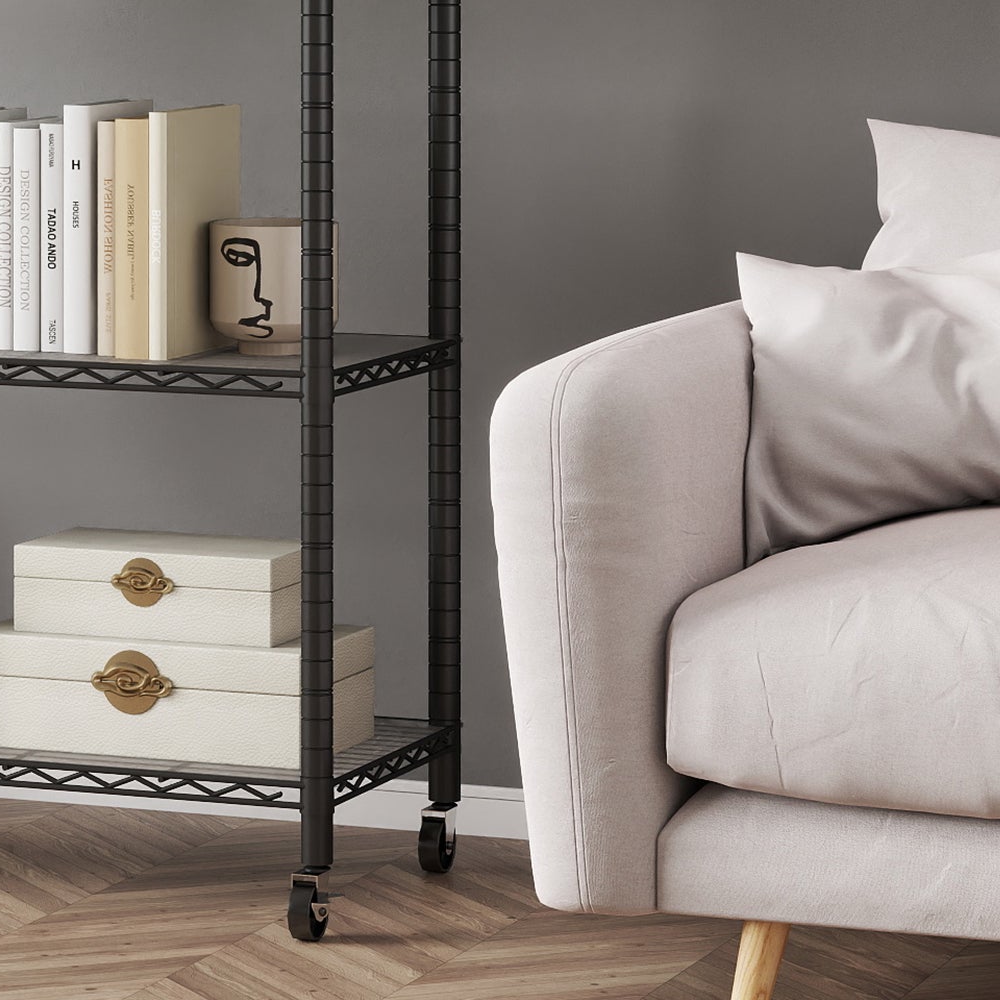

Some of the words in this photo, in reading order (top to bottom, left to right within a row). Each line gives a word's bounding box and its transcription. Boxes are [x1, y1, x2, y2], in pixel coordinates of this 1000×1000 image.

[71, 160, 81, 170] H
[20, 170, 30, 221] DESIGN
[47, 208, 57, 242] TADAO
[20, 225, 30, 311] COLLECTION
[47, 244, 57, 270] ANDO
